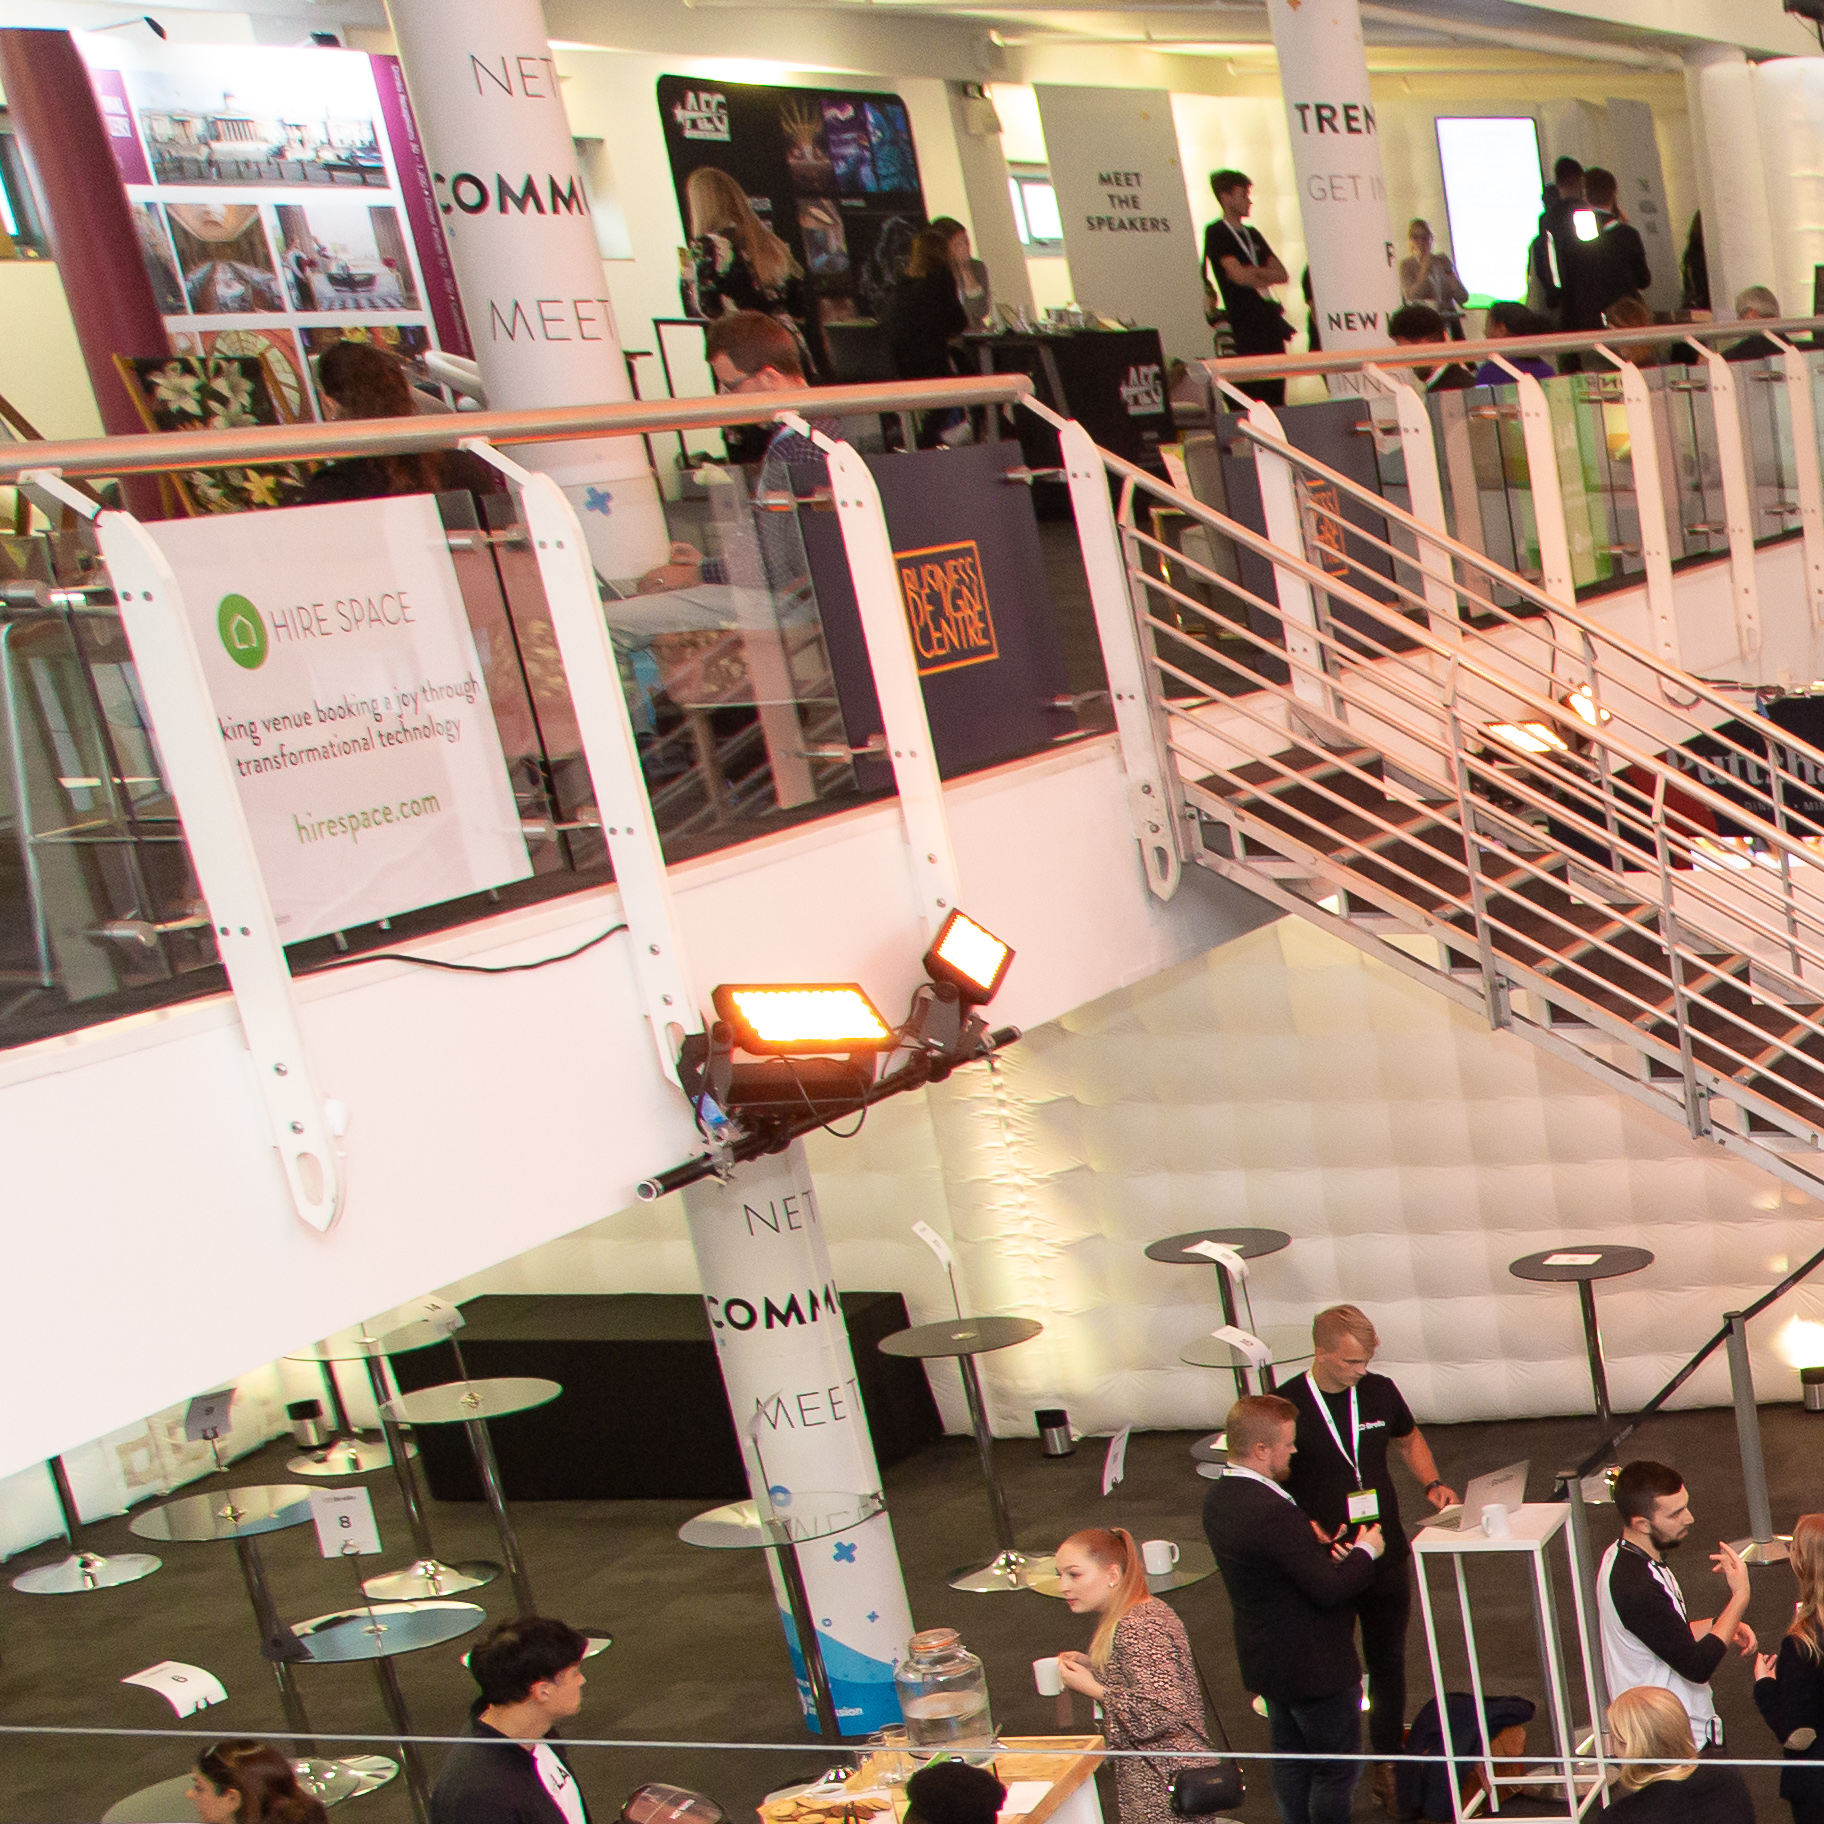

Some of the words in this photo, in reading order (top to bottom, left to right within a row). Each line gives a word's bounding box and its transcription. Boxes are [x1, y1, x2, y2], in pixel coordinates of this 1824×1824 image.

[1098, 170, 1143, 189] MEET
[1106, 192, 1143, 211] THE
[1085, 215, 1171, 234] SPEAKERS
[1326, 311, 1379, 332] NEW
[269, 602, 333, 644] HIRE
[335, 590, 416, 634] SPACE
[260, 709, 312, 734] venue
[312, 694, 383, 724] booking
[420, 671, 481, 704] through
[235, 727, 377, 778] transformational
[376, 713, 462, 748] technology
[292, 793, 442, 845] hirespace.com
